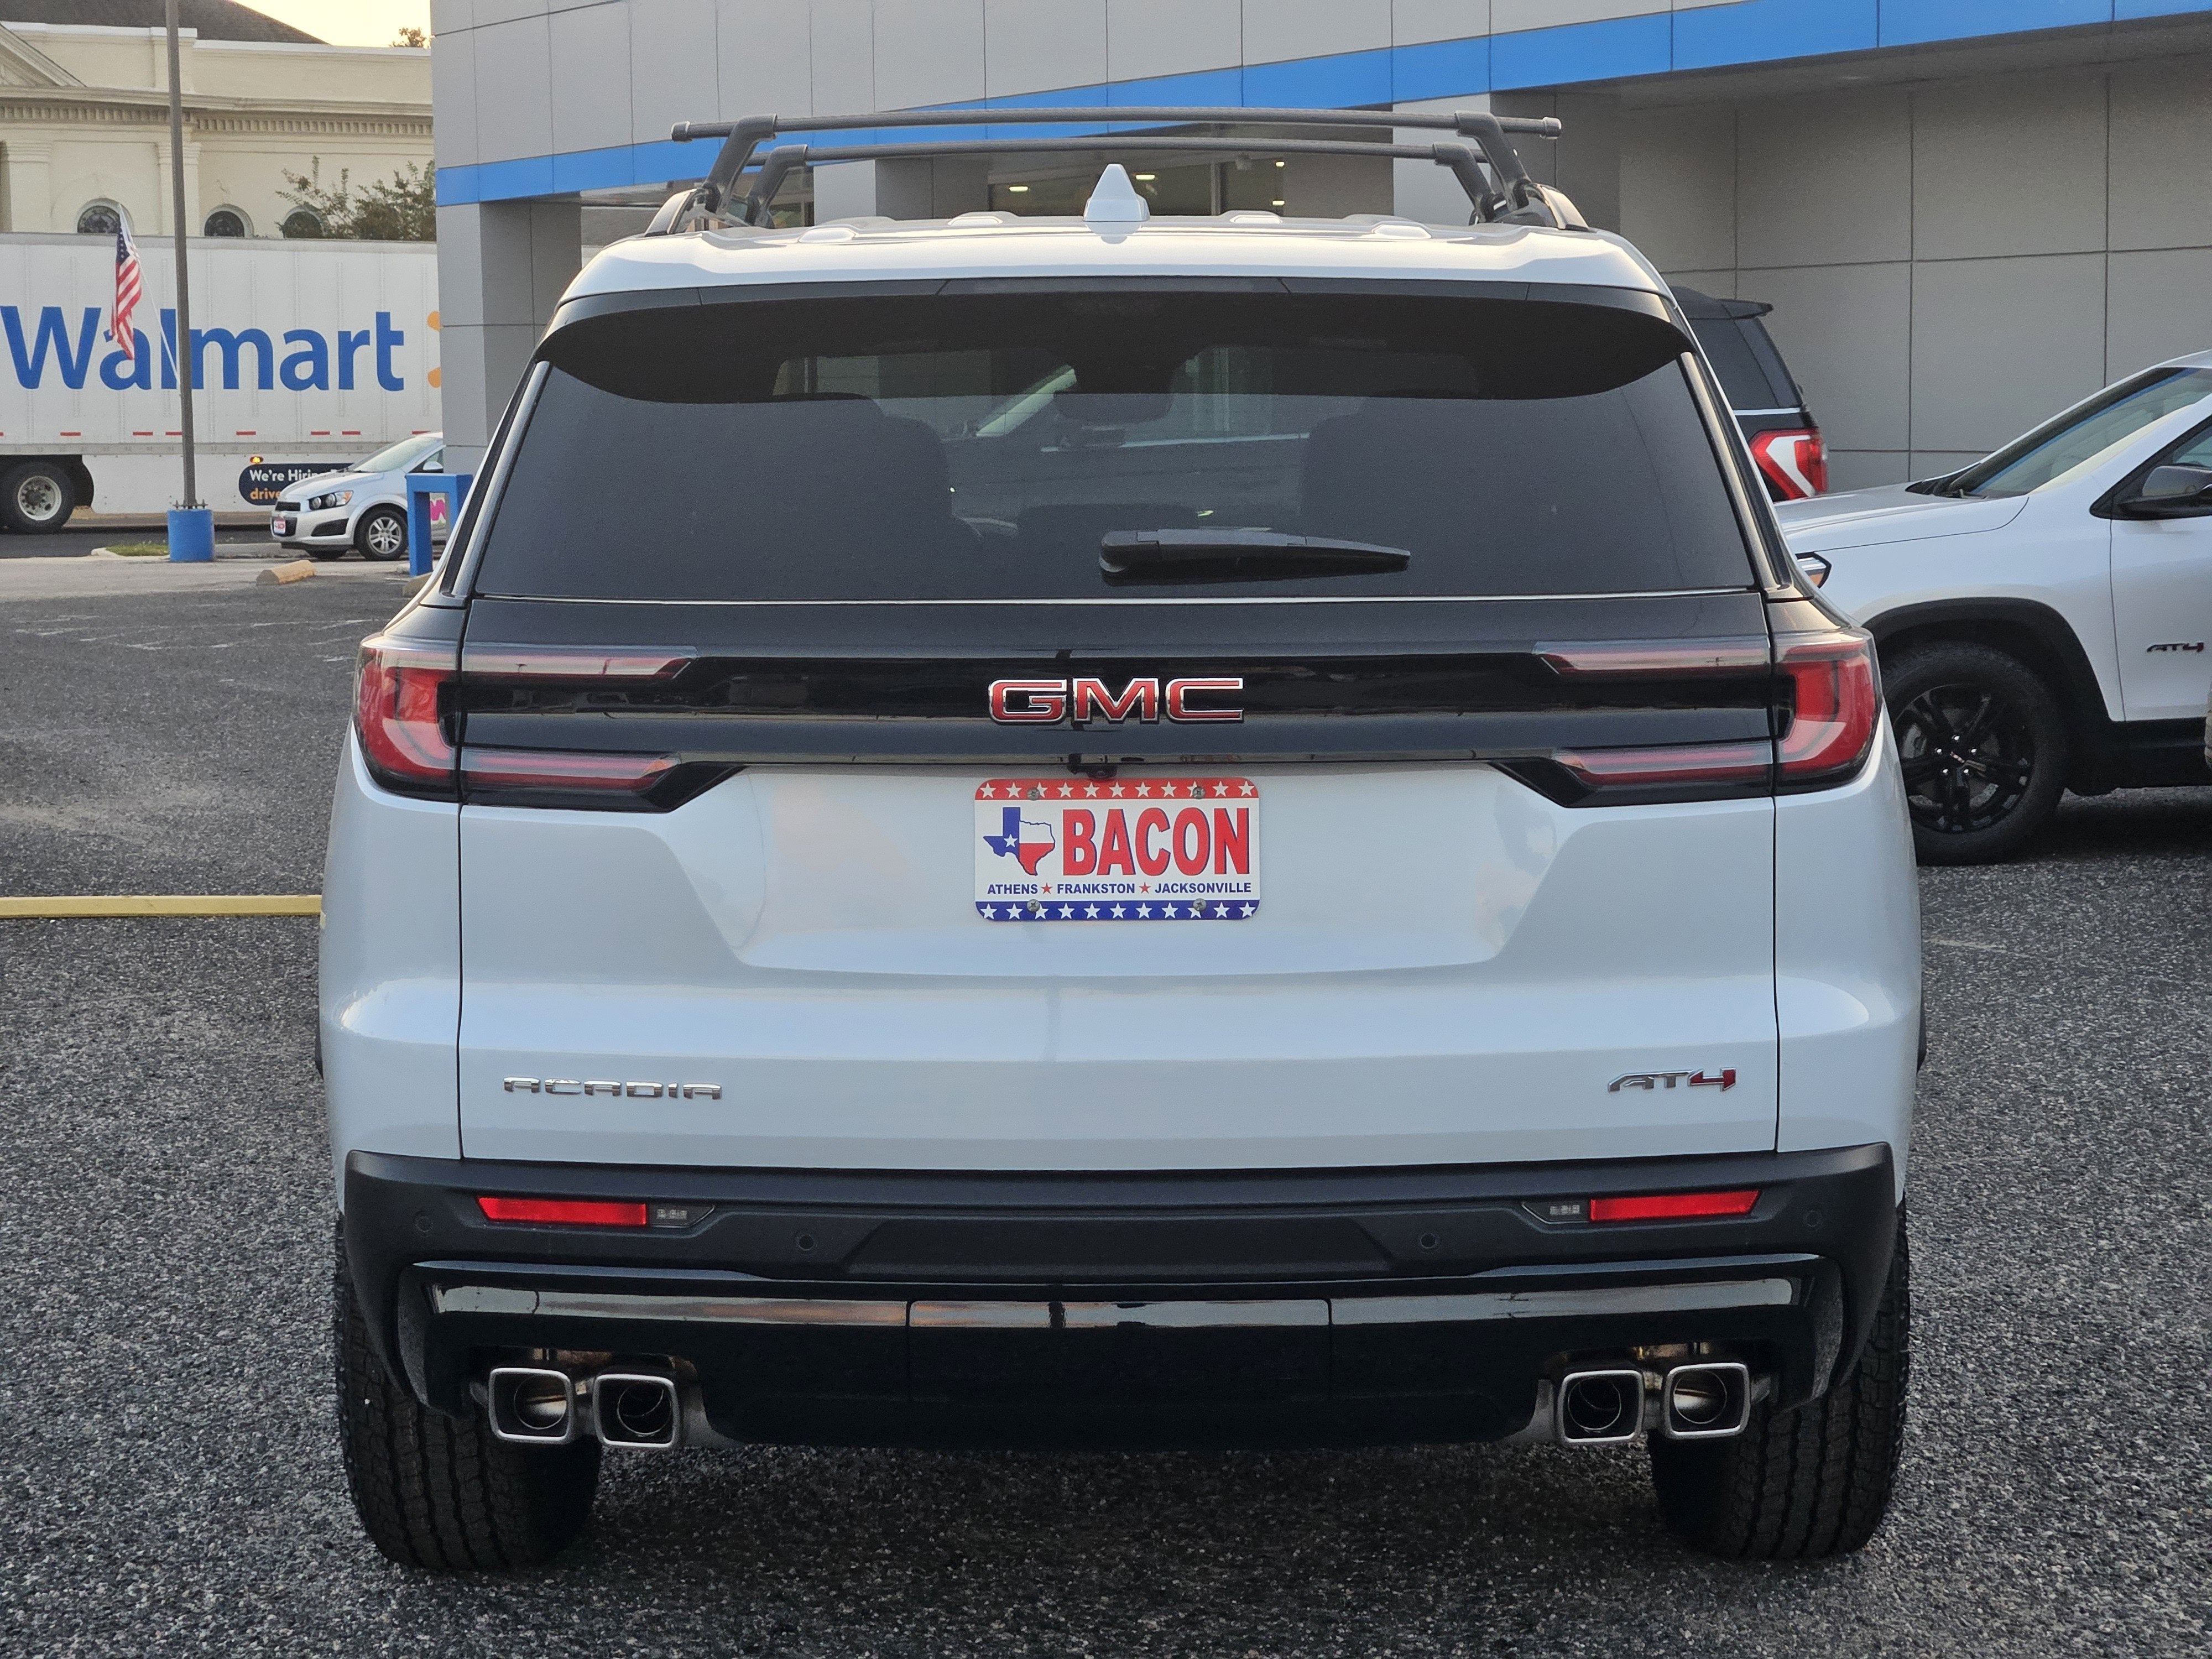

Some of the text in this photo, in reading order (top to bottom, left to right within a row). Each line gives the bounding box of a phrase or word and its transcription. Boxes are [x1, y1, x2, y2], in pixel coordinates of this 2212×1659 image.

[0, 306, 404, 392] Walmart
[249, 469, 285, 482] We're
[2147, 642, 2204, 653] AT4
[988, 677, 1244, 724] GMC
[1062, 807, 1250, 876] BACON
[987, 882, 1251, 894] ATHENS FRANKSTON JACKSONVILLE
[503, 1076, 722, 1100] ACADIA
[1608, 1067, 1737, 1092] AT4
